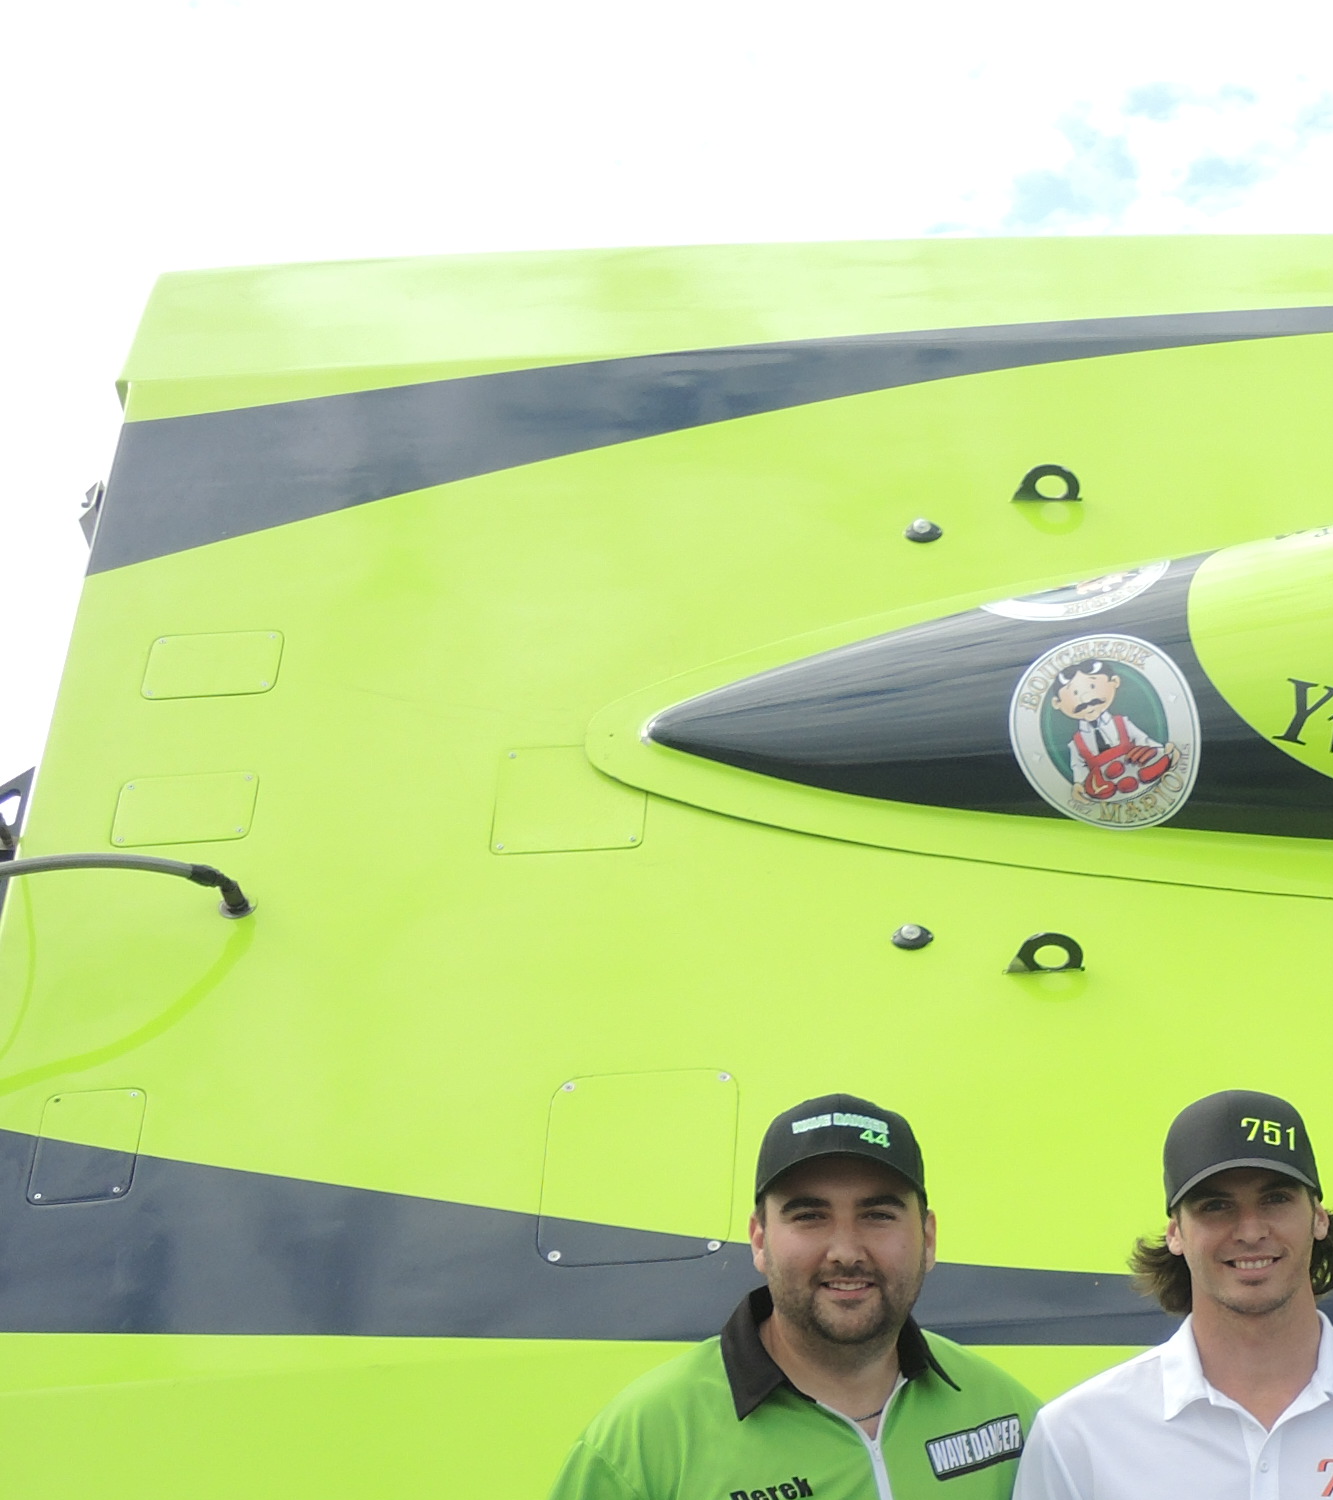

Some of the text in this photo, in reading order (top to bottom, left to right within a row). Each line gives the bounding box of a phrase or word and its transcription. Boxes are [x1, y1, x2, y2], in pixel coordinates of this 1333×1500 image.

[1018, 640, 1153, 712] BOUCHERIE
[1100, 770, 1185, 824] MARIO
[860, 1130, 890, 1148] 44
[1241, 1117, 1296, 1151] 751
[929, 1434, 973, 1472] WAVE
